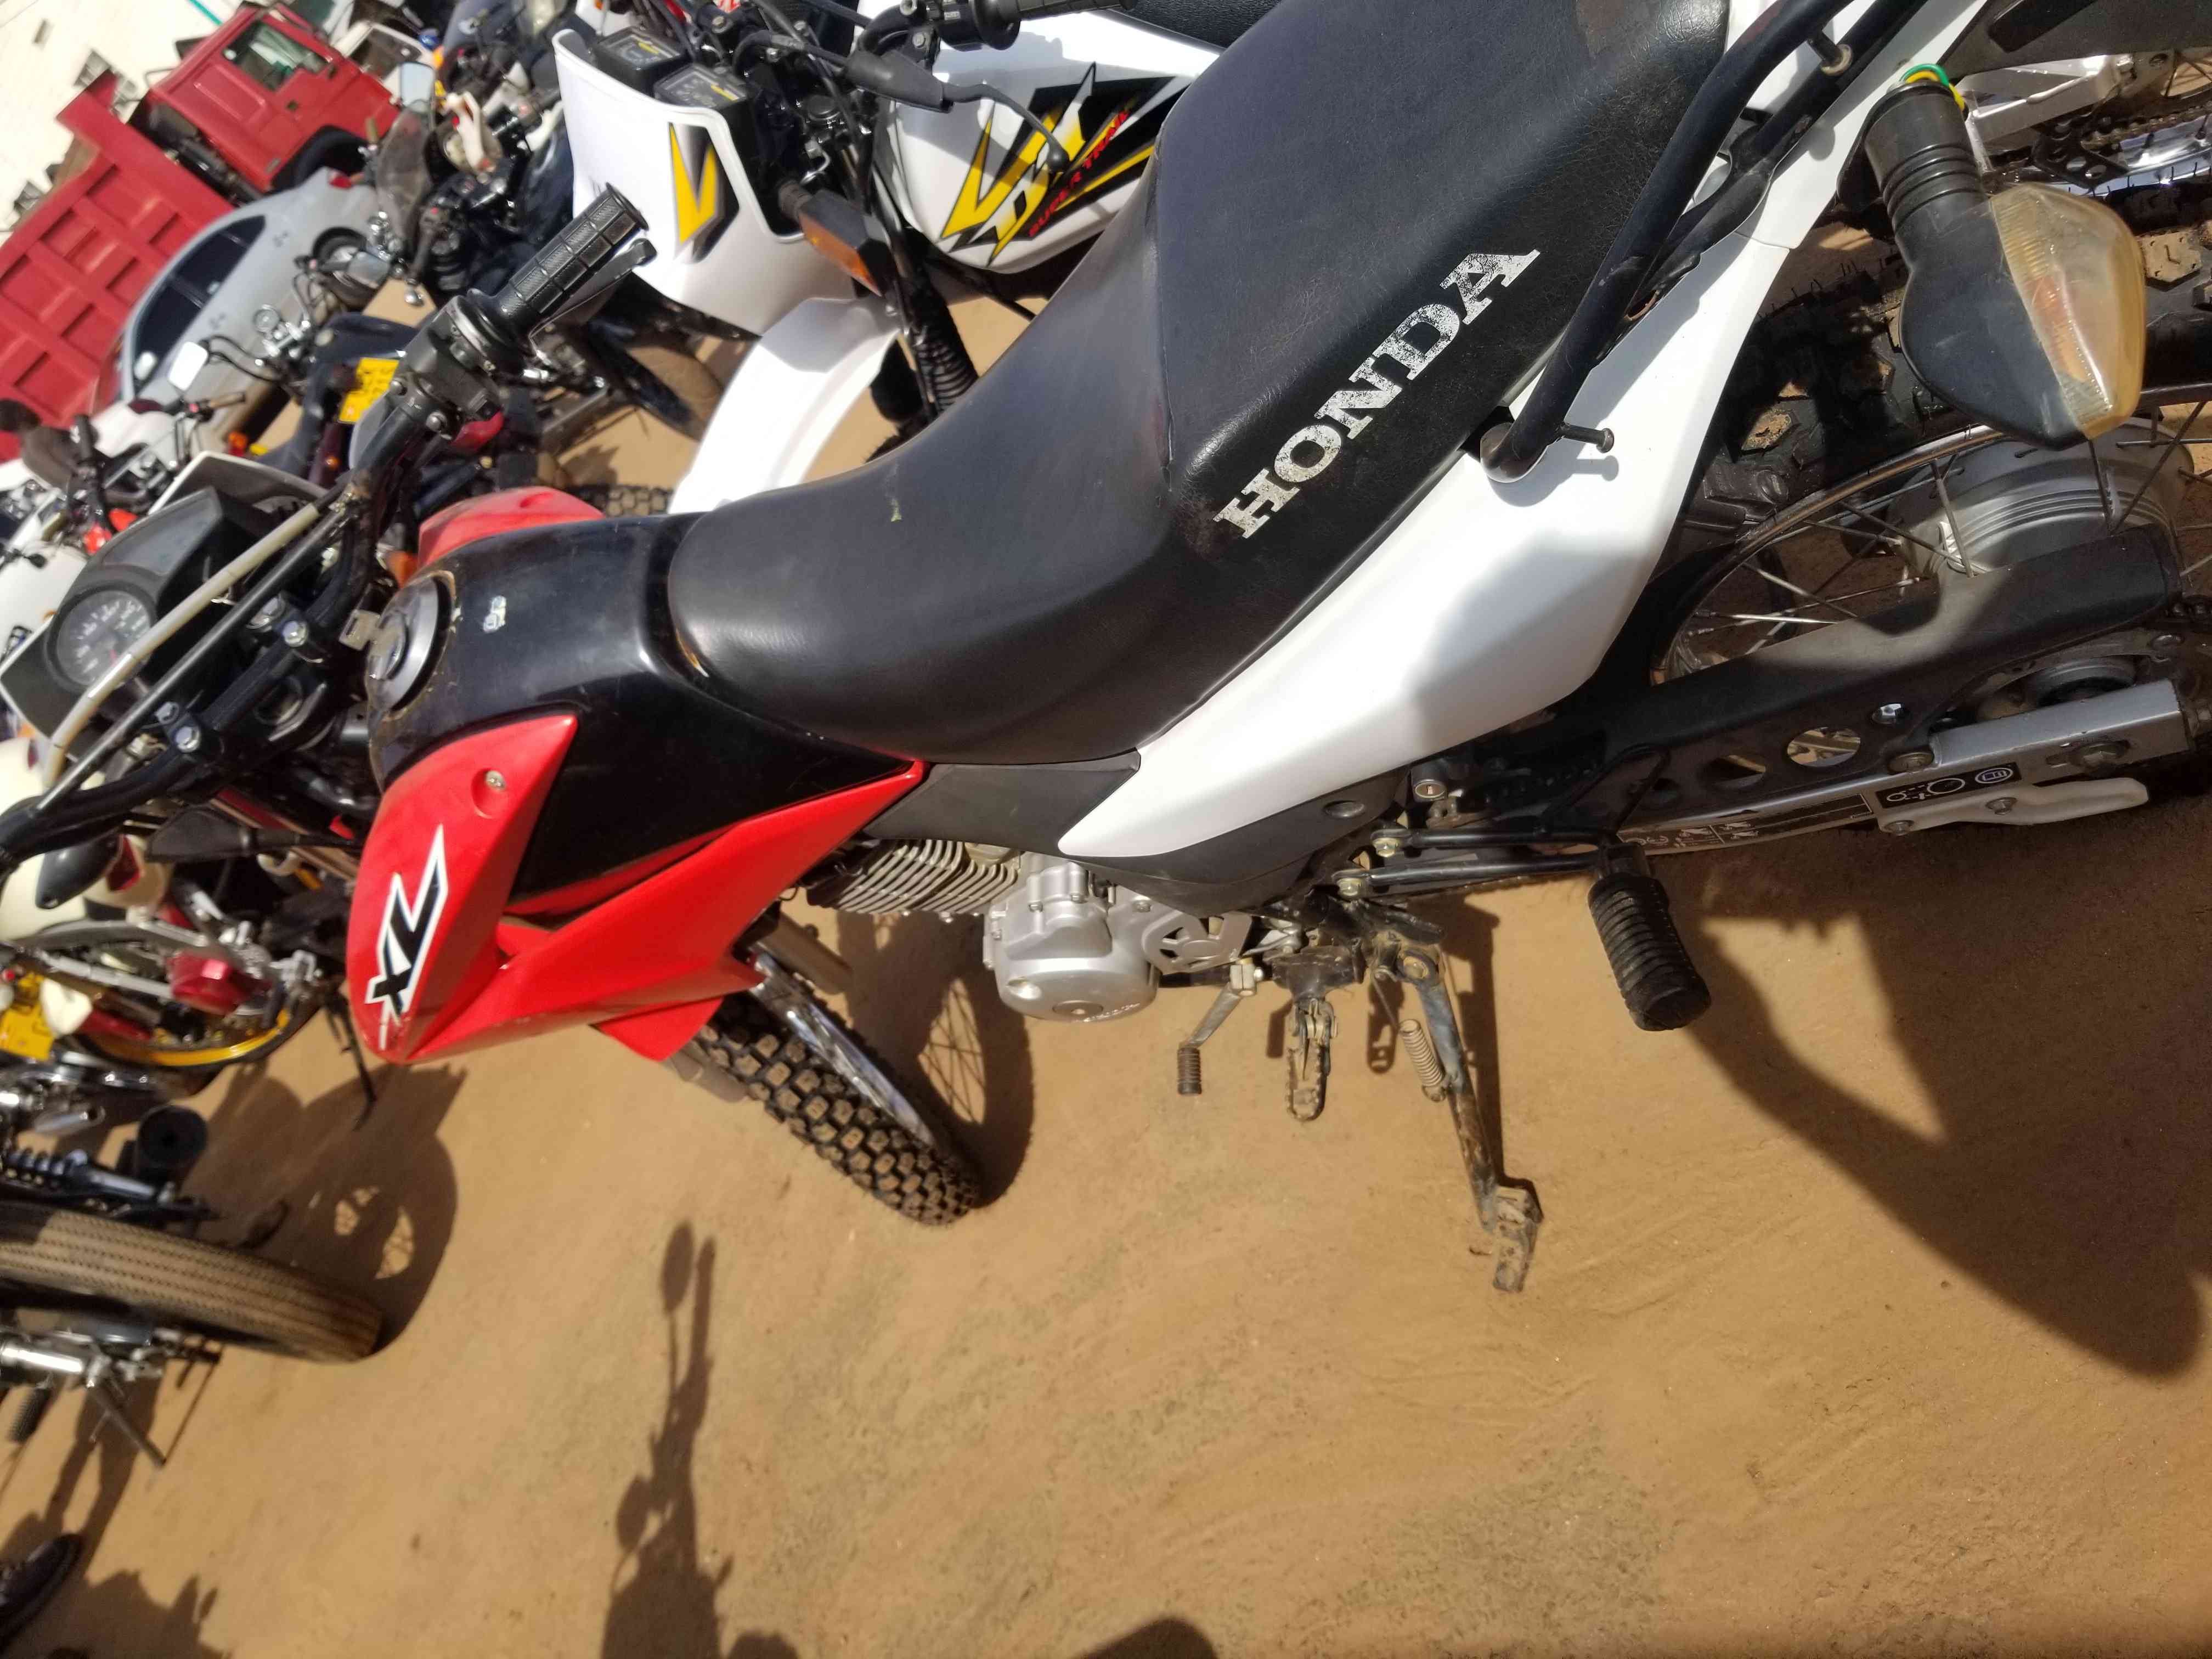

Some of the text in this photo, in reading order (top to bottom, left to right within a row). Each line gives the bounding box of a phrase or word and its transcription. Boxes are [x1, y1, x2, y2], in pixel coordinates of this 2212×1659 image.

[1082, 111, 1130, 168] TRAIL
[1212, 249, 1541, 538] HONDA
[364, 823, 448, 1029] XL
